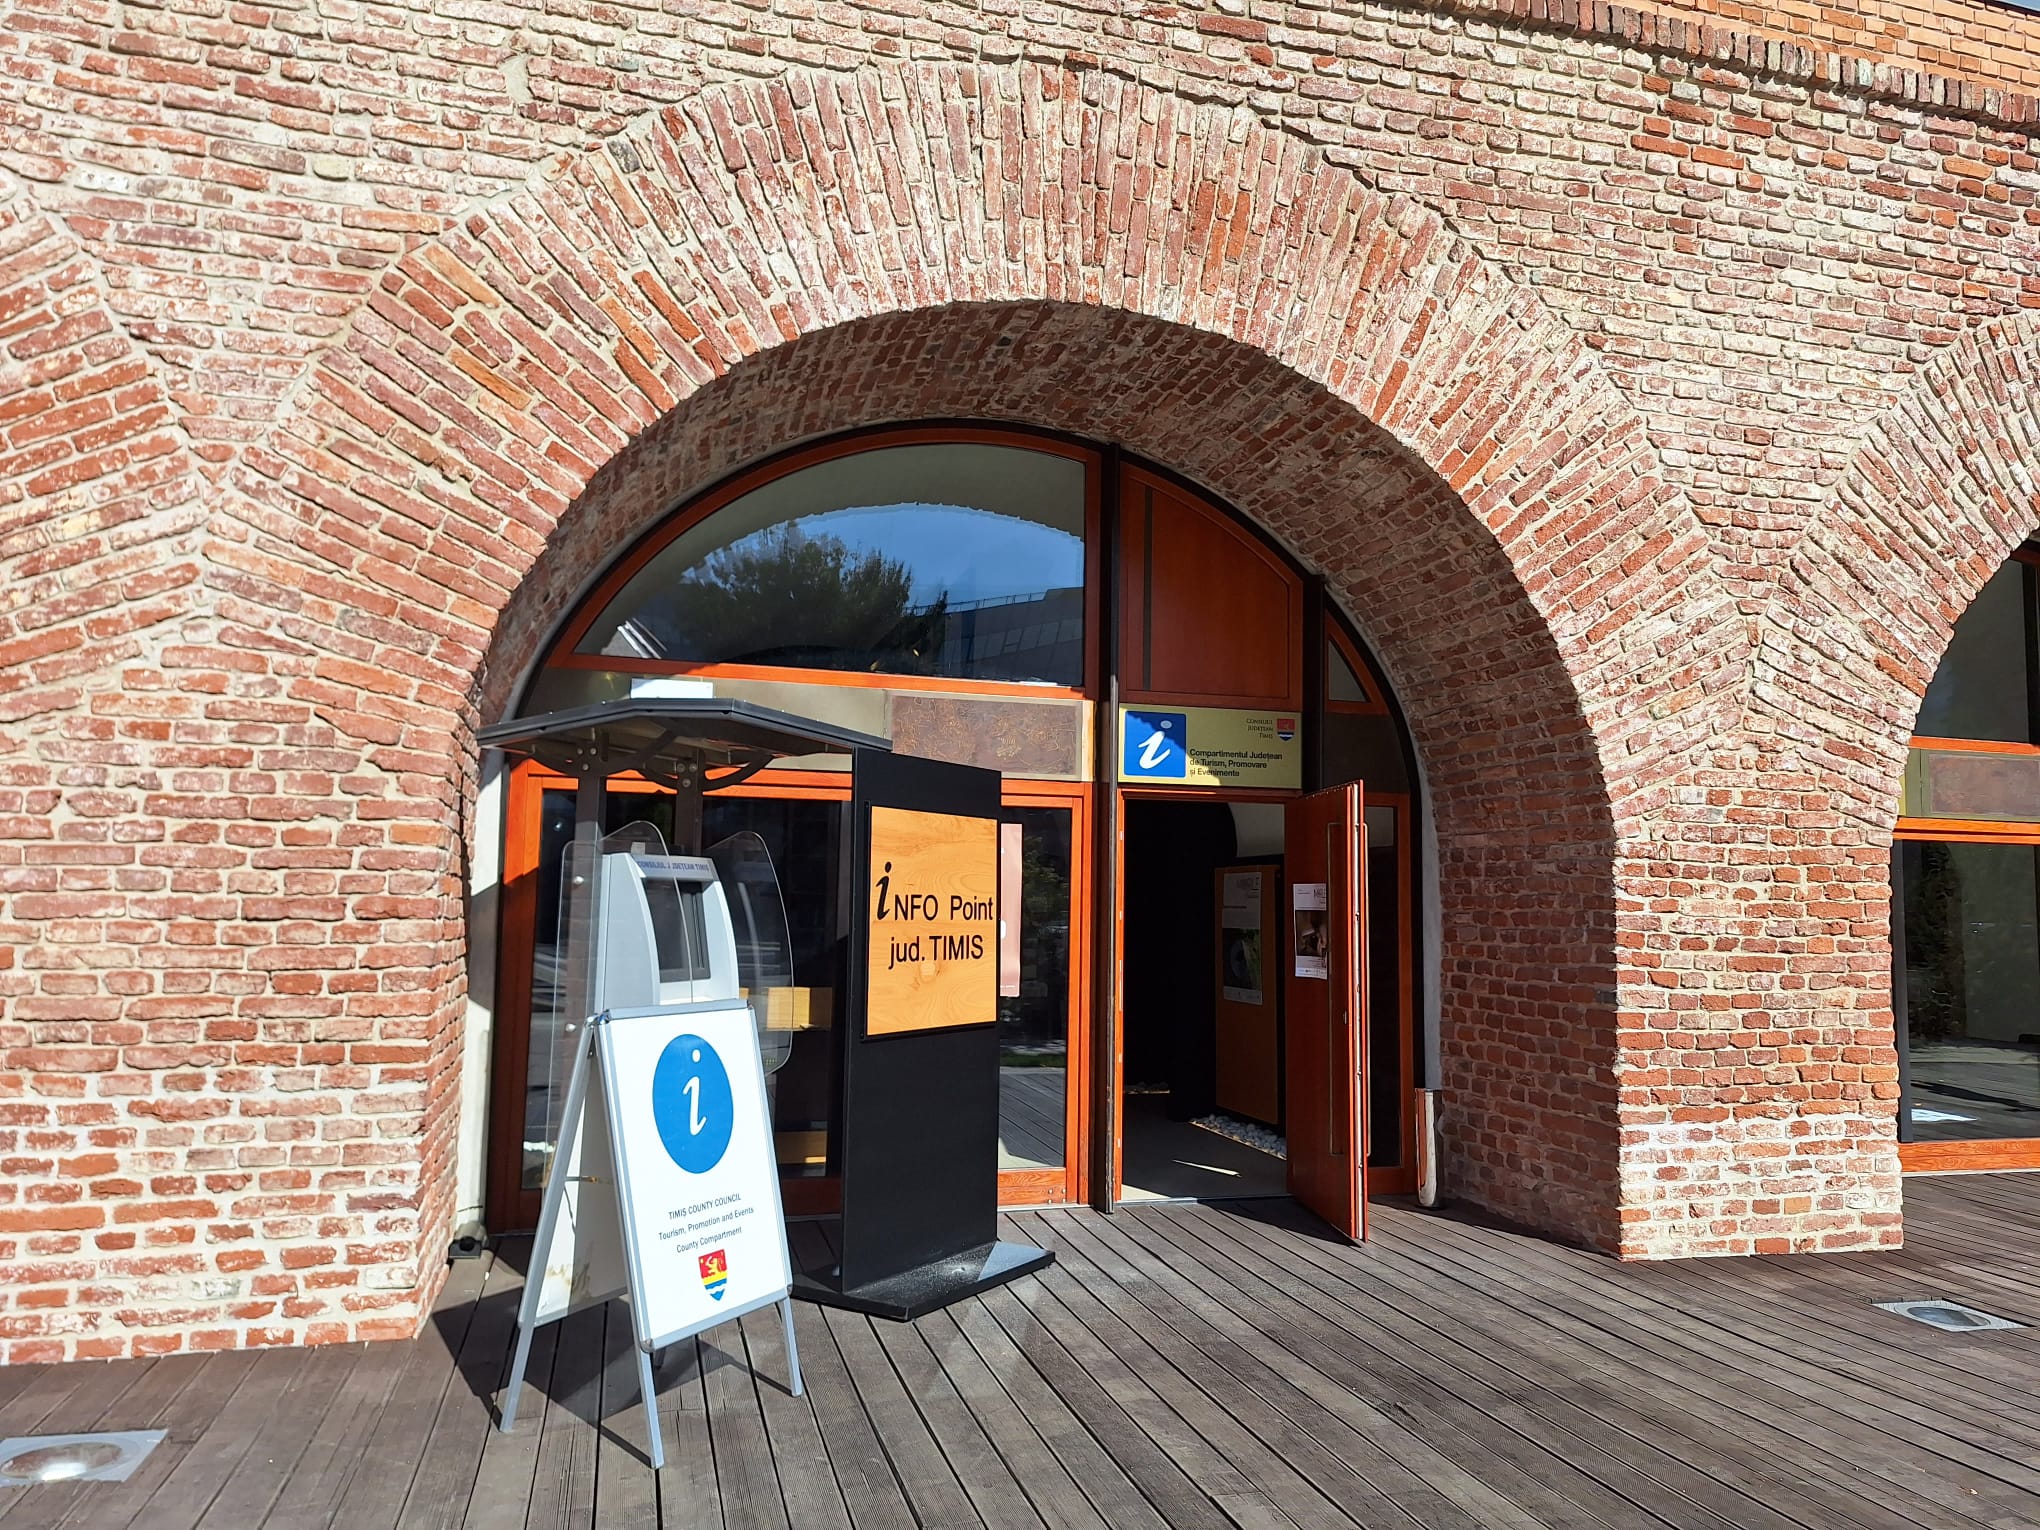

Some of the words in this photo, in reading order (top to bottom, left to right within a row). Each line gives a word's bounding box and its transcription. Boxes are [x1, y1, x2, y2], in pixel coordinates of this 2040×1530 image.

[1189, 748, 1248, 759] Compartimentul
[1189, 758, 1200, 766] de
[1200, 759, 1227, 768] Turism,
[1228, 760, 1267, 769] Promovare
[950, 895, 993, 921] Point
[888, 936, 926, 970] jud.
[929, 934, 984, 961] TIMIS
[668, 1207, 687, 1220] TIMIS
[688, 1200, 714, 1215] COUNTY
[714, 1193, 742, 1207] COUNCIL
[658, 1227, 687, 1241] Tourism,
[688, 1217, 721, 1232] Promotion
[721, 1211, 734, 1222] and
[734, 1206, 754, 1218] Events
[676, 1240, 699, 1253] County
[699, 1226, 742, 1246] Compartment
